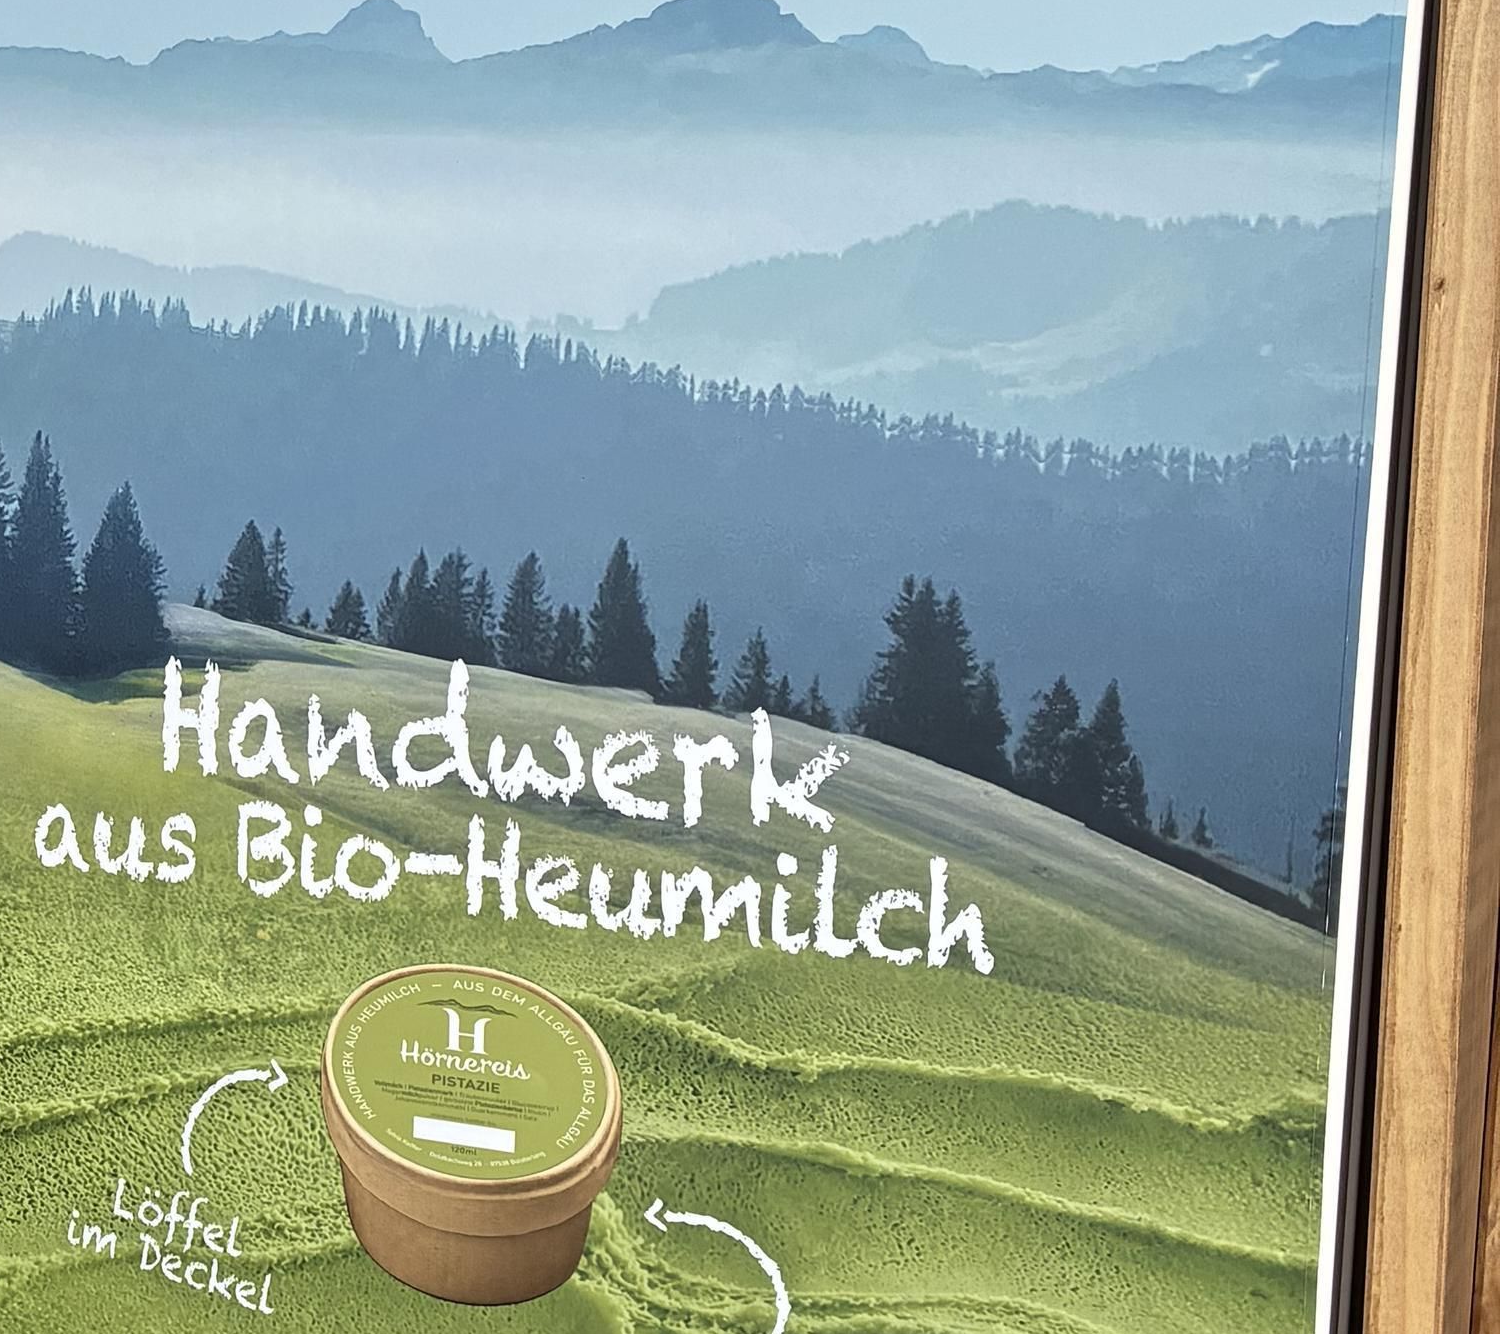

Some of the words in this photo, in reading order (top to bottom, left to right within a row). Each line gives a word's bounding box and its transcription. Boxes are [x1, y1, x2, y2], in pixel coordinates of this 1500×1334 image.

[161, 654, 850, 835] Handwerk
[33, 802, 198, 884] aus
[235, 798, 995, 978] Bio-Heumilch
[358, 982, 421, 1025] HEUMILCH
[453, 979, 485, 993] AUS
[491, 985, 527, 1007] DEM
[345, 1023, 362, 1050] AUS
[528, 1004, 579, 1046] ALLGÄU
[399, 1038, 531, 1081] Hörnereis
[572, 1042, 594, 1075] FÜR
[341, 1049, 377, 1120] HANDWERK
[431, 1073, 501, 1094] PISTAZIE
[581, 1078, 596, 1104] DAS
[555, 1106, 593, 1149] ALLGÄU
[450, 1145, 478, 1156] 120ml
[112, 1177, 244, 1259] Löffel
[66, 1209, 117, 1260] im
[138, 1231, 275, 1316] Deckel
